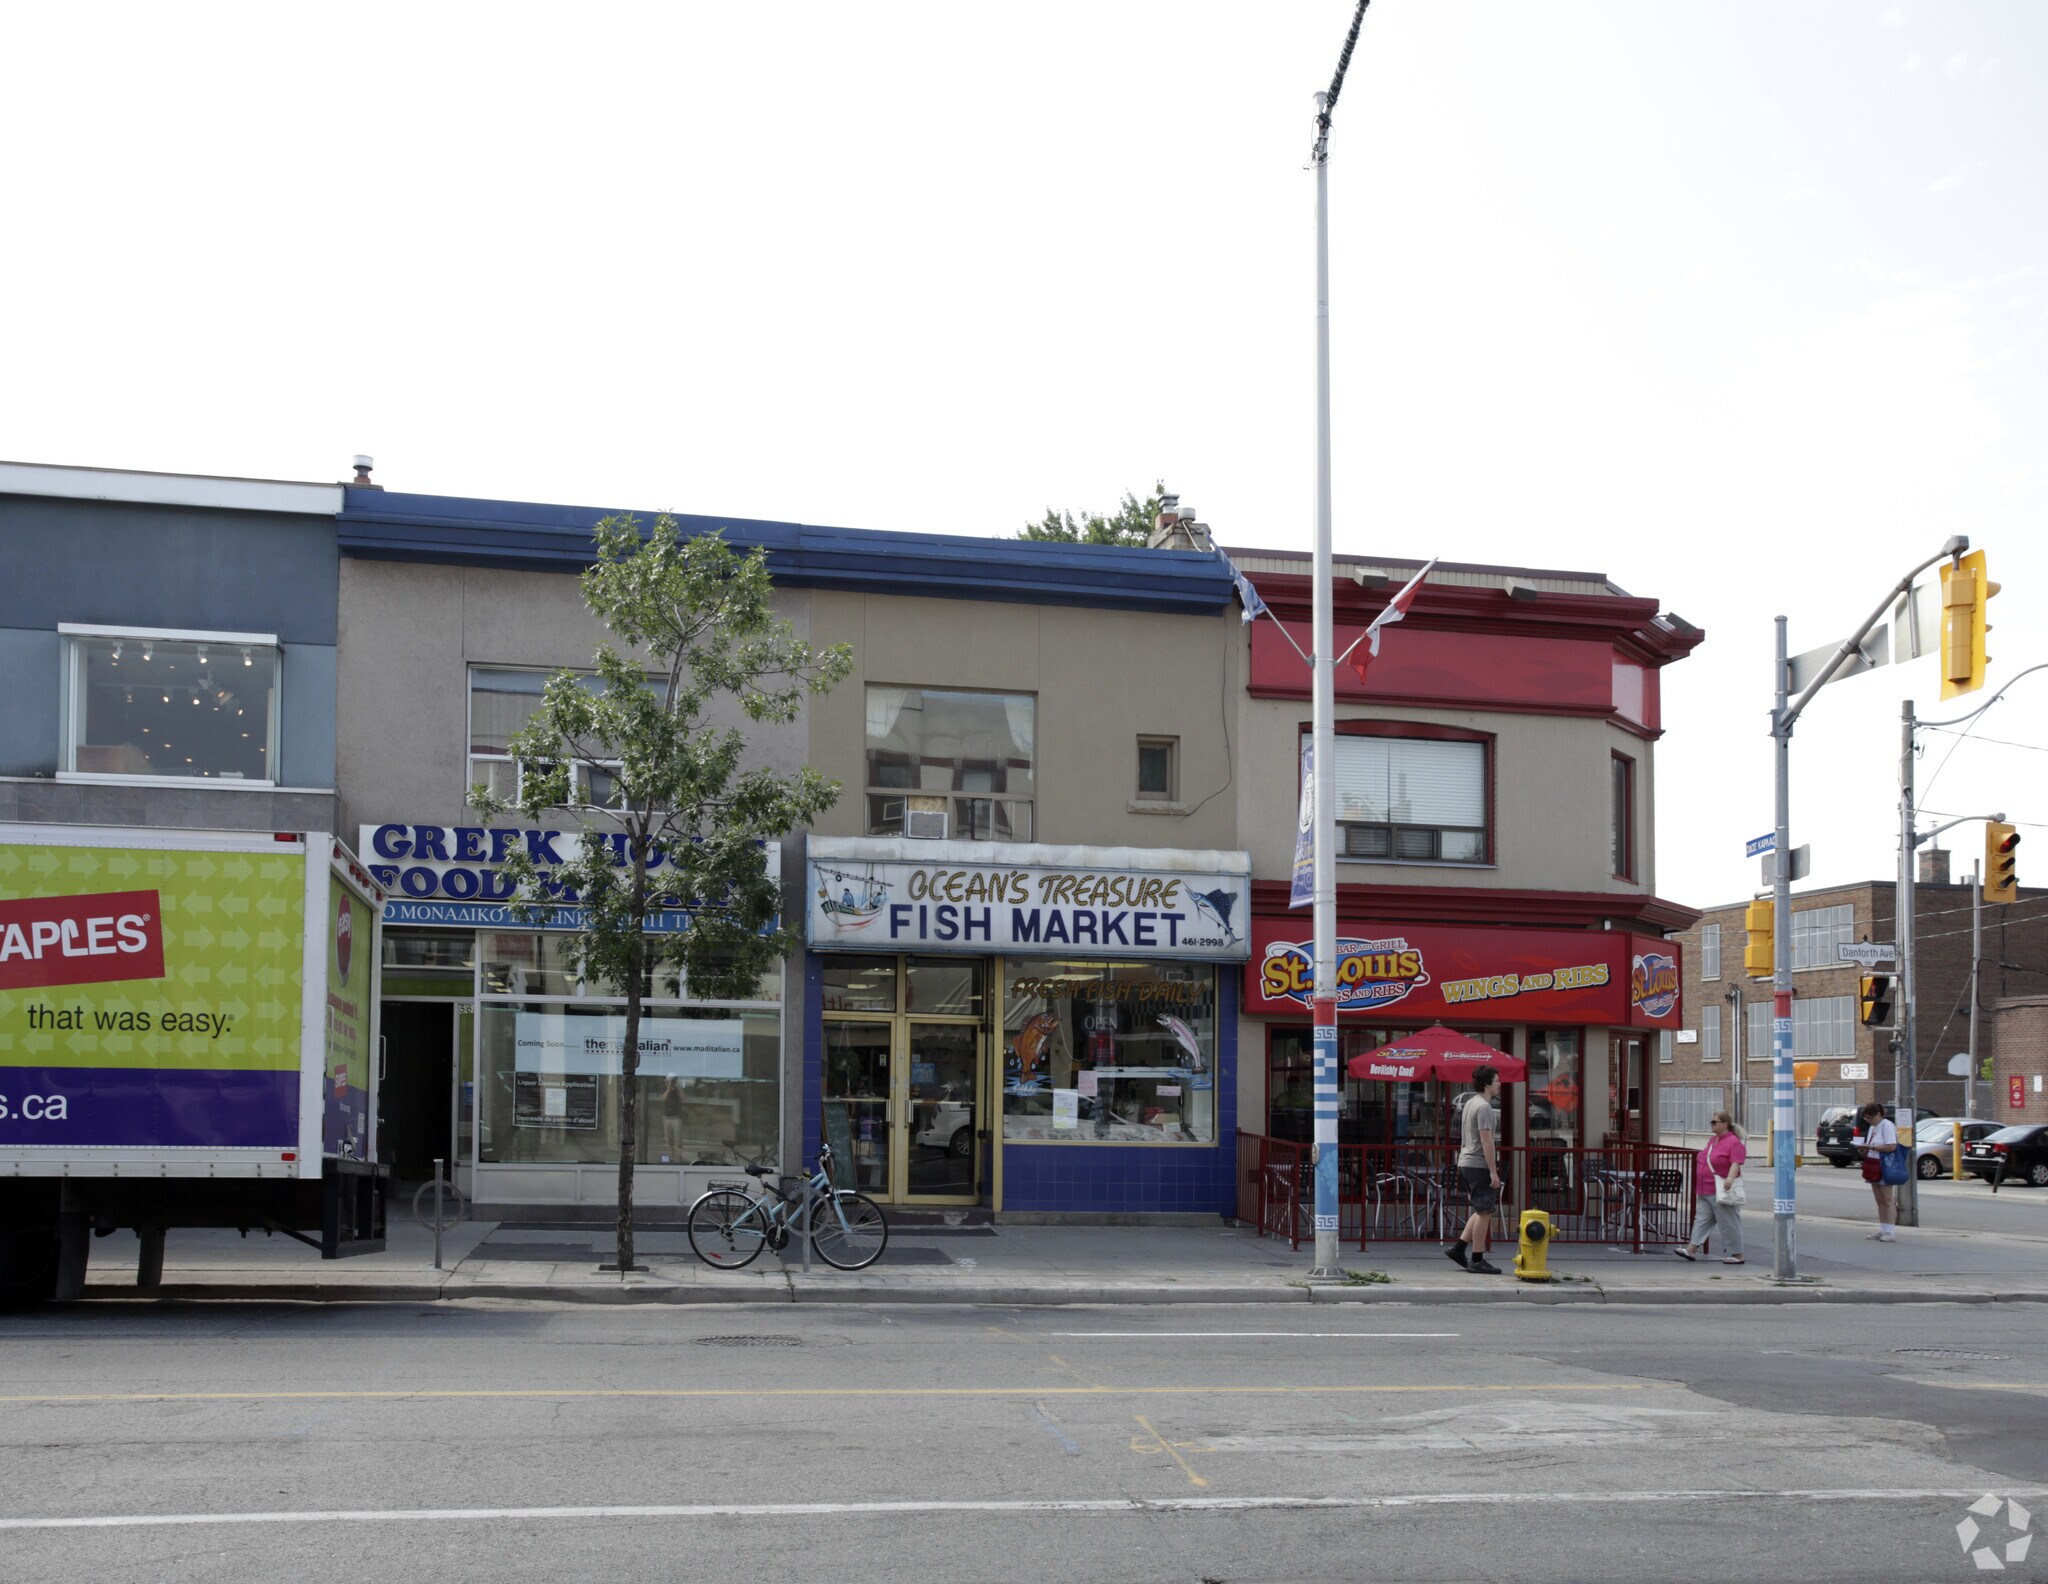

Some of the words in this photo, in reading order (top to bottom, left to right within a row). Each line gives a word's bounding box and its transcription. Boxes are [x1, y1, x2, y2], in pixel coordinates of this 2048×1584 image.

[373, 824, 564, 865] GREEK
[368, 865, 517, 899] FOOD
[907, 870, 1029, 904] OCEAN'S
[1038, 874, 1182, 909] TREASURE
[0, 914, 148, 962] APLES
[890, 903, 992, 941] FISH
[1011, 907, 1186, 947] MARKET
[1335, 951, 1422, 985] ouis
[1842, 947, 1878, 958] Danforth
[1880, 948, 1894, 958] Ave
[1011, 977, 1080, 999] FRESH
[1086, 980, 1130, 1000] FISH
[1138, 981, 1205, 1004] DAILY
[1353, 989, 1371, 999] AND
[1372, 983, 1405, 998] RIBS
[1441, 973, 1520, 1004] WINGS
[1520, 973, 1553, 991] AND
[1553, 963, 1609, 990] RIBS
[28, 1003, 84, 1030] that
[95, 1010, 151, 1031] was
[1084, 1015, 1118, 1030] OPEN
[517, 1039, 544, 1048] Coming
[673, 1044, 741, 1053] www.maditalian.ca
[1370, 1064, 1398, 1077] Devilishly
